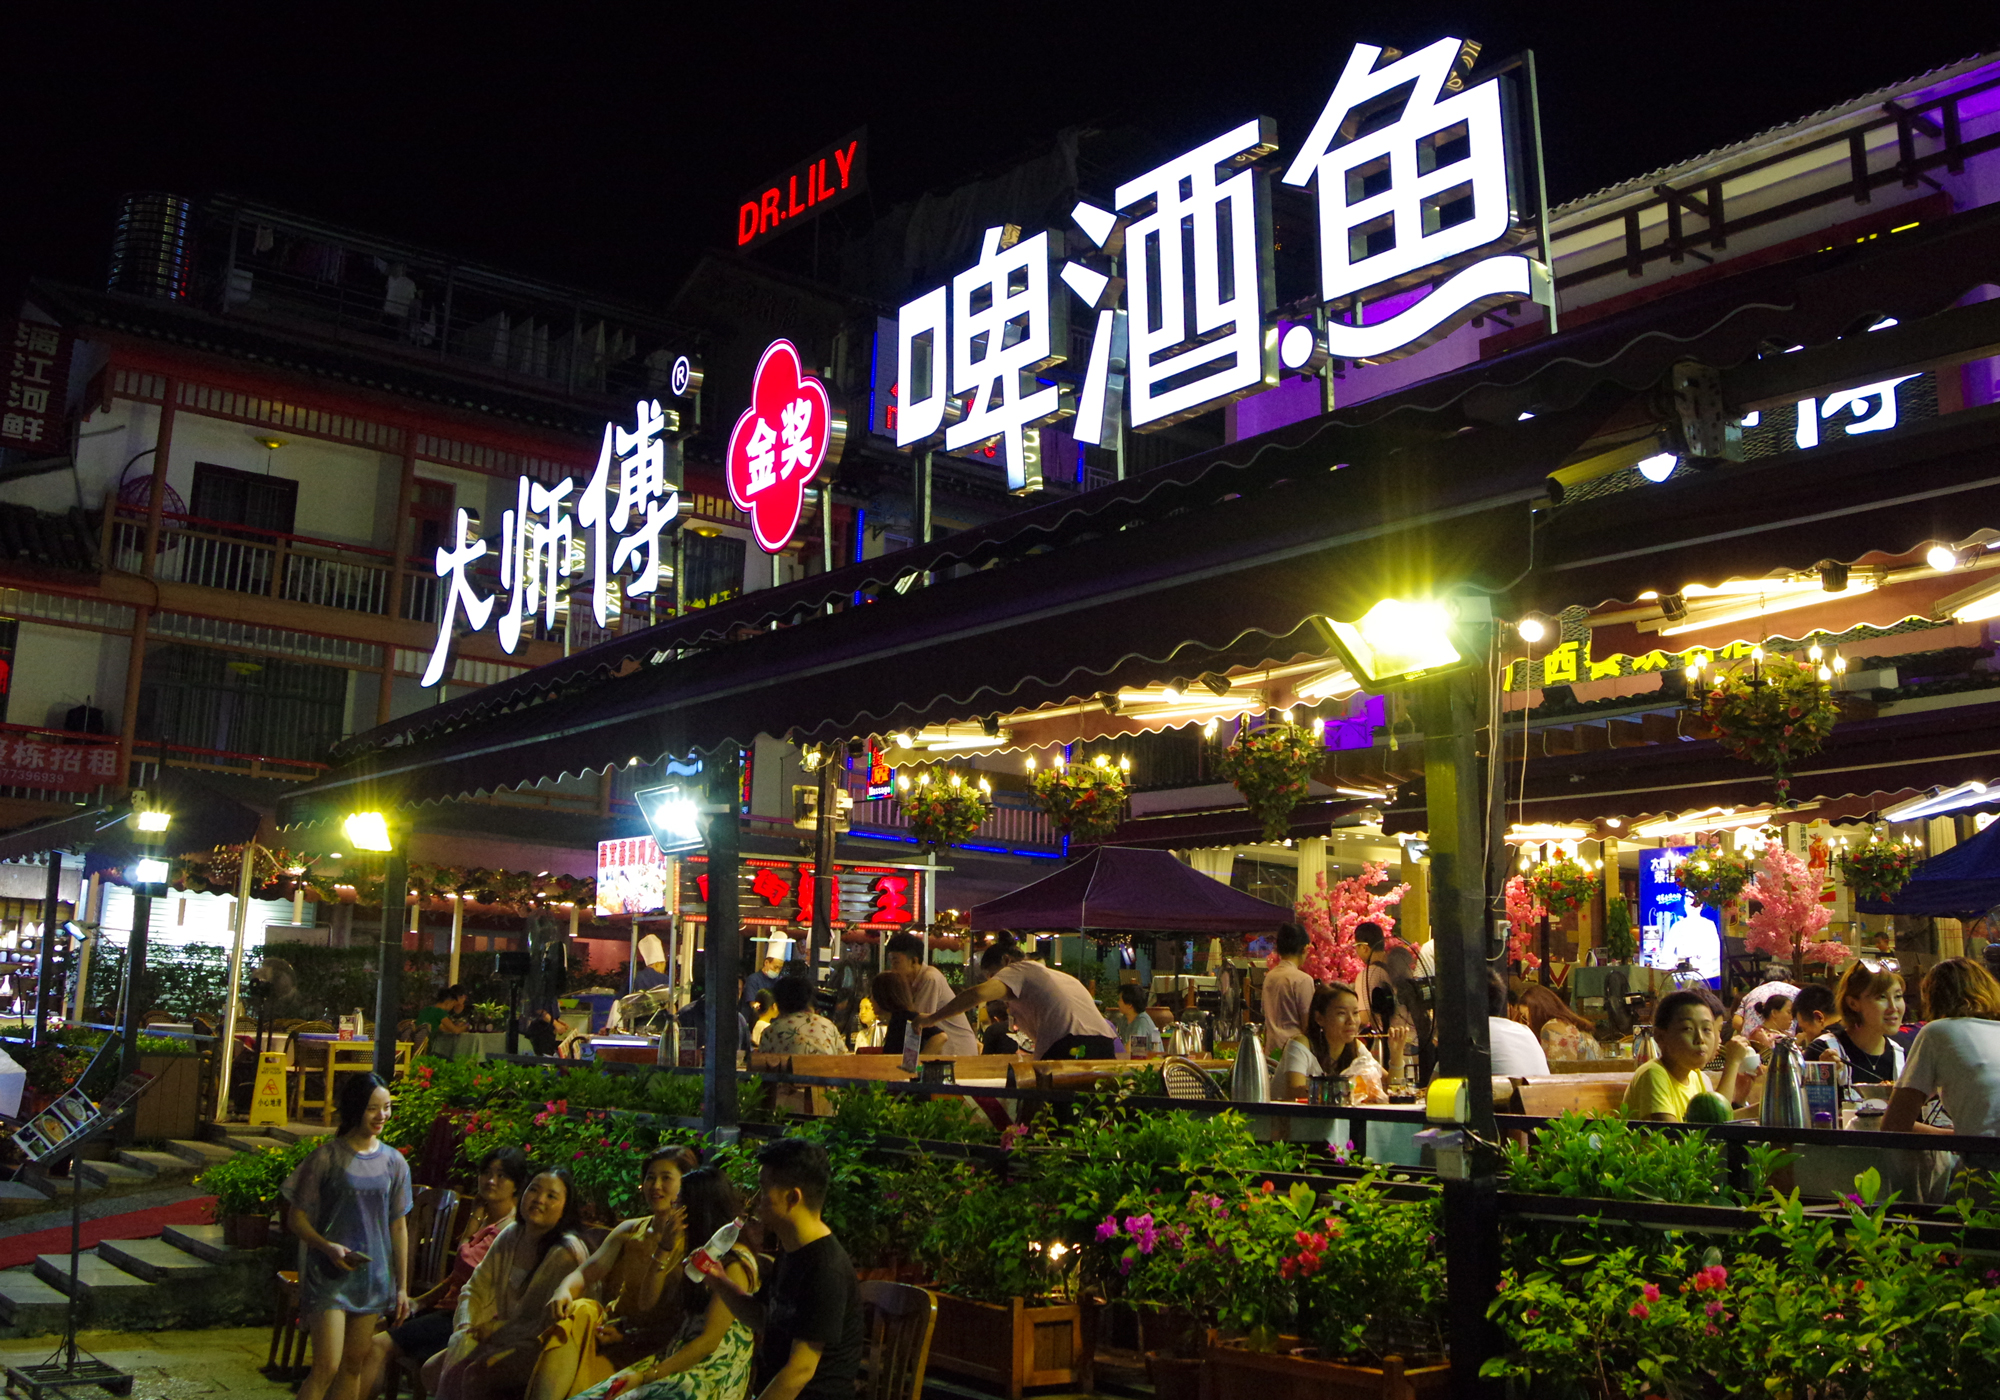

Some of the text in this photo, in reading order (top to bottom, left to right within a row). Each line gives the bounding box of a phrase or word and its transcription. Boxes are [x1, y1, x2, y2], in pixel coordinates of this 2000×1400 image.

[738, 140, 858, 246] DR.LILY
[896, 36, 1531, 490] 啤酒鱼
[745, 397, 813, 496] 金奖
[420, 399, 679, 688] 大师傅
[0, 739, 118, 777] 栋招租
